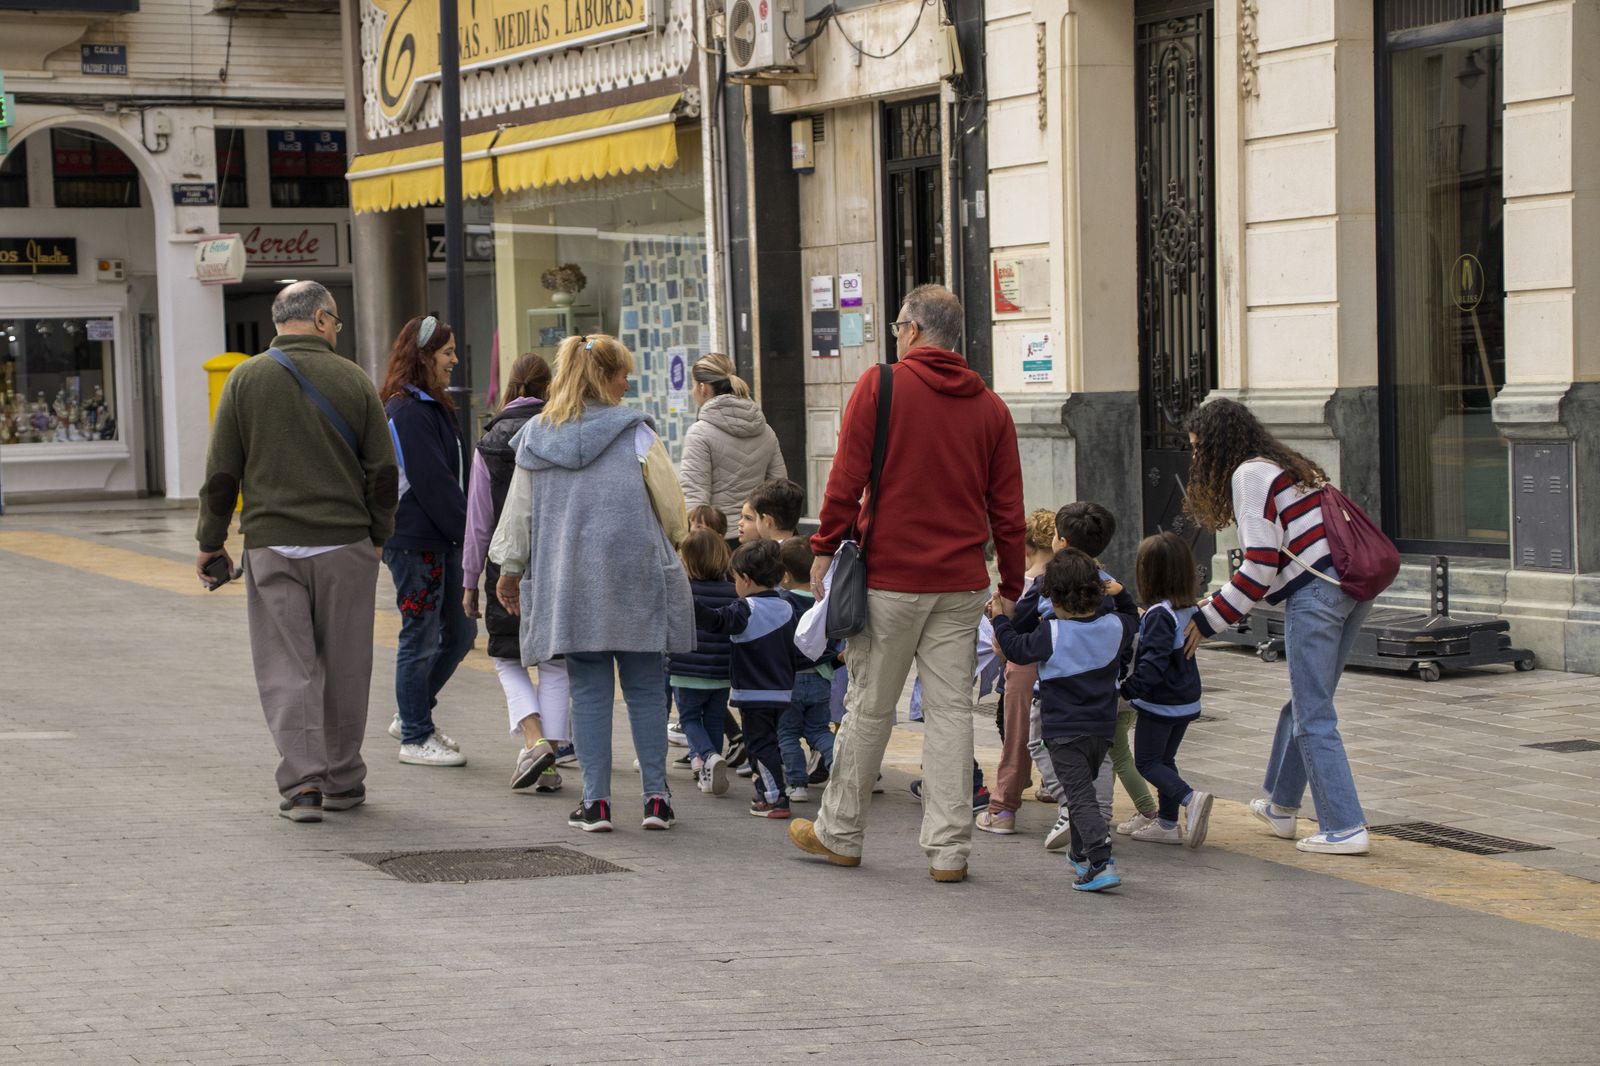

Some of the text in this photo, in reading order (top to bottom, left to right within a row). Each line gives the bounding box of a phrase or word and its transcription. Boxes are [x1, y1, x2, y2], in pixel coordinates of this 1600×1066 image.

[437, 23, 481, 67] NAS
[494, 4, 550, 51] MEDIAS
[564, 0, 634, 35] LABORES
[94, 46, 120, 55] CALLE
[243, 226, 319, 255] Lerele
